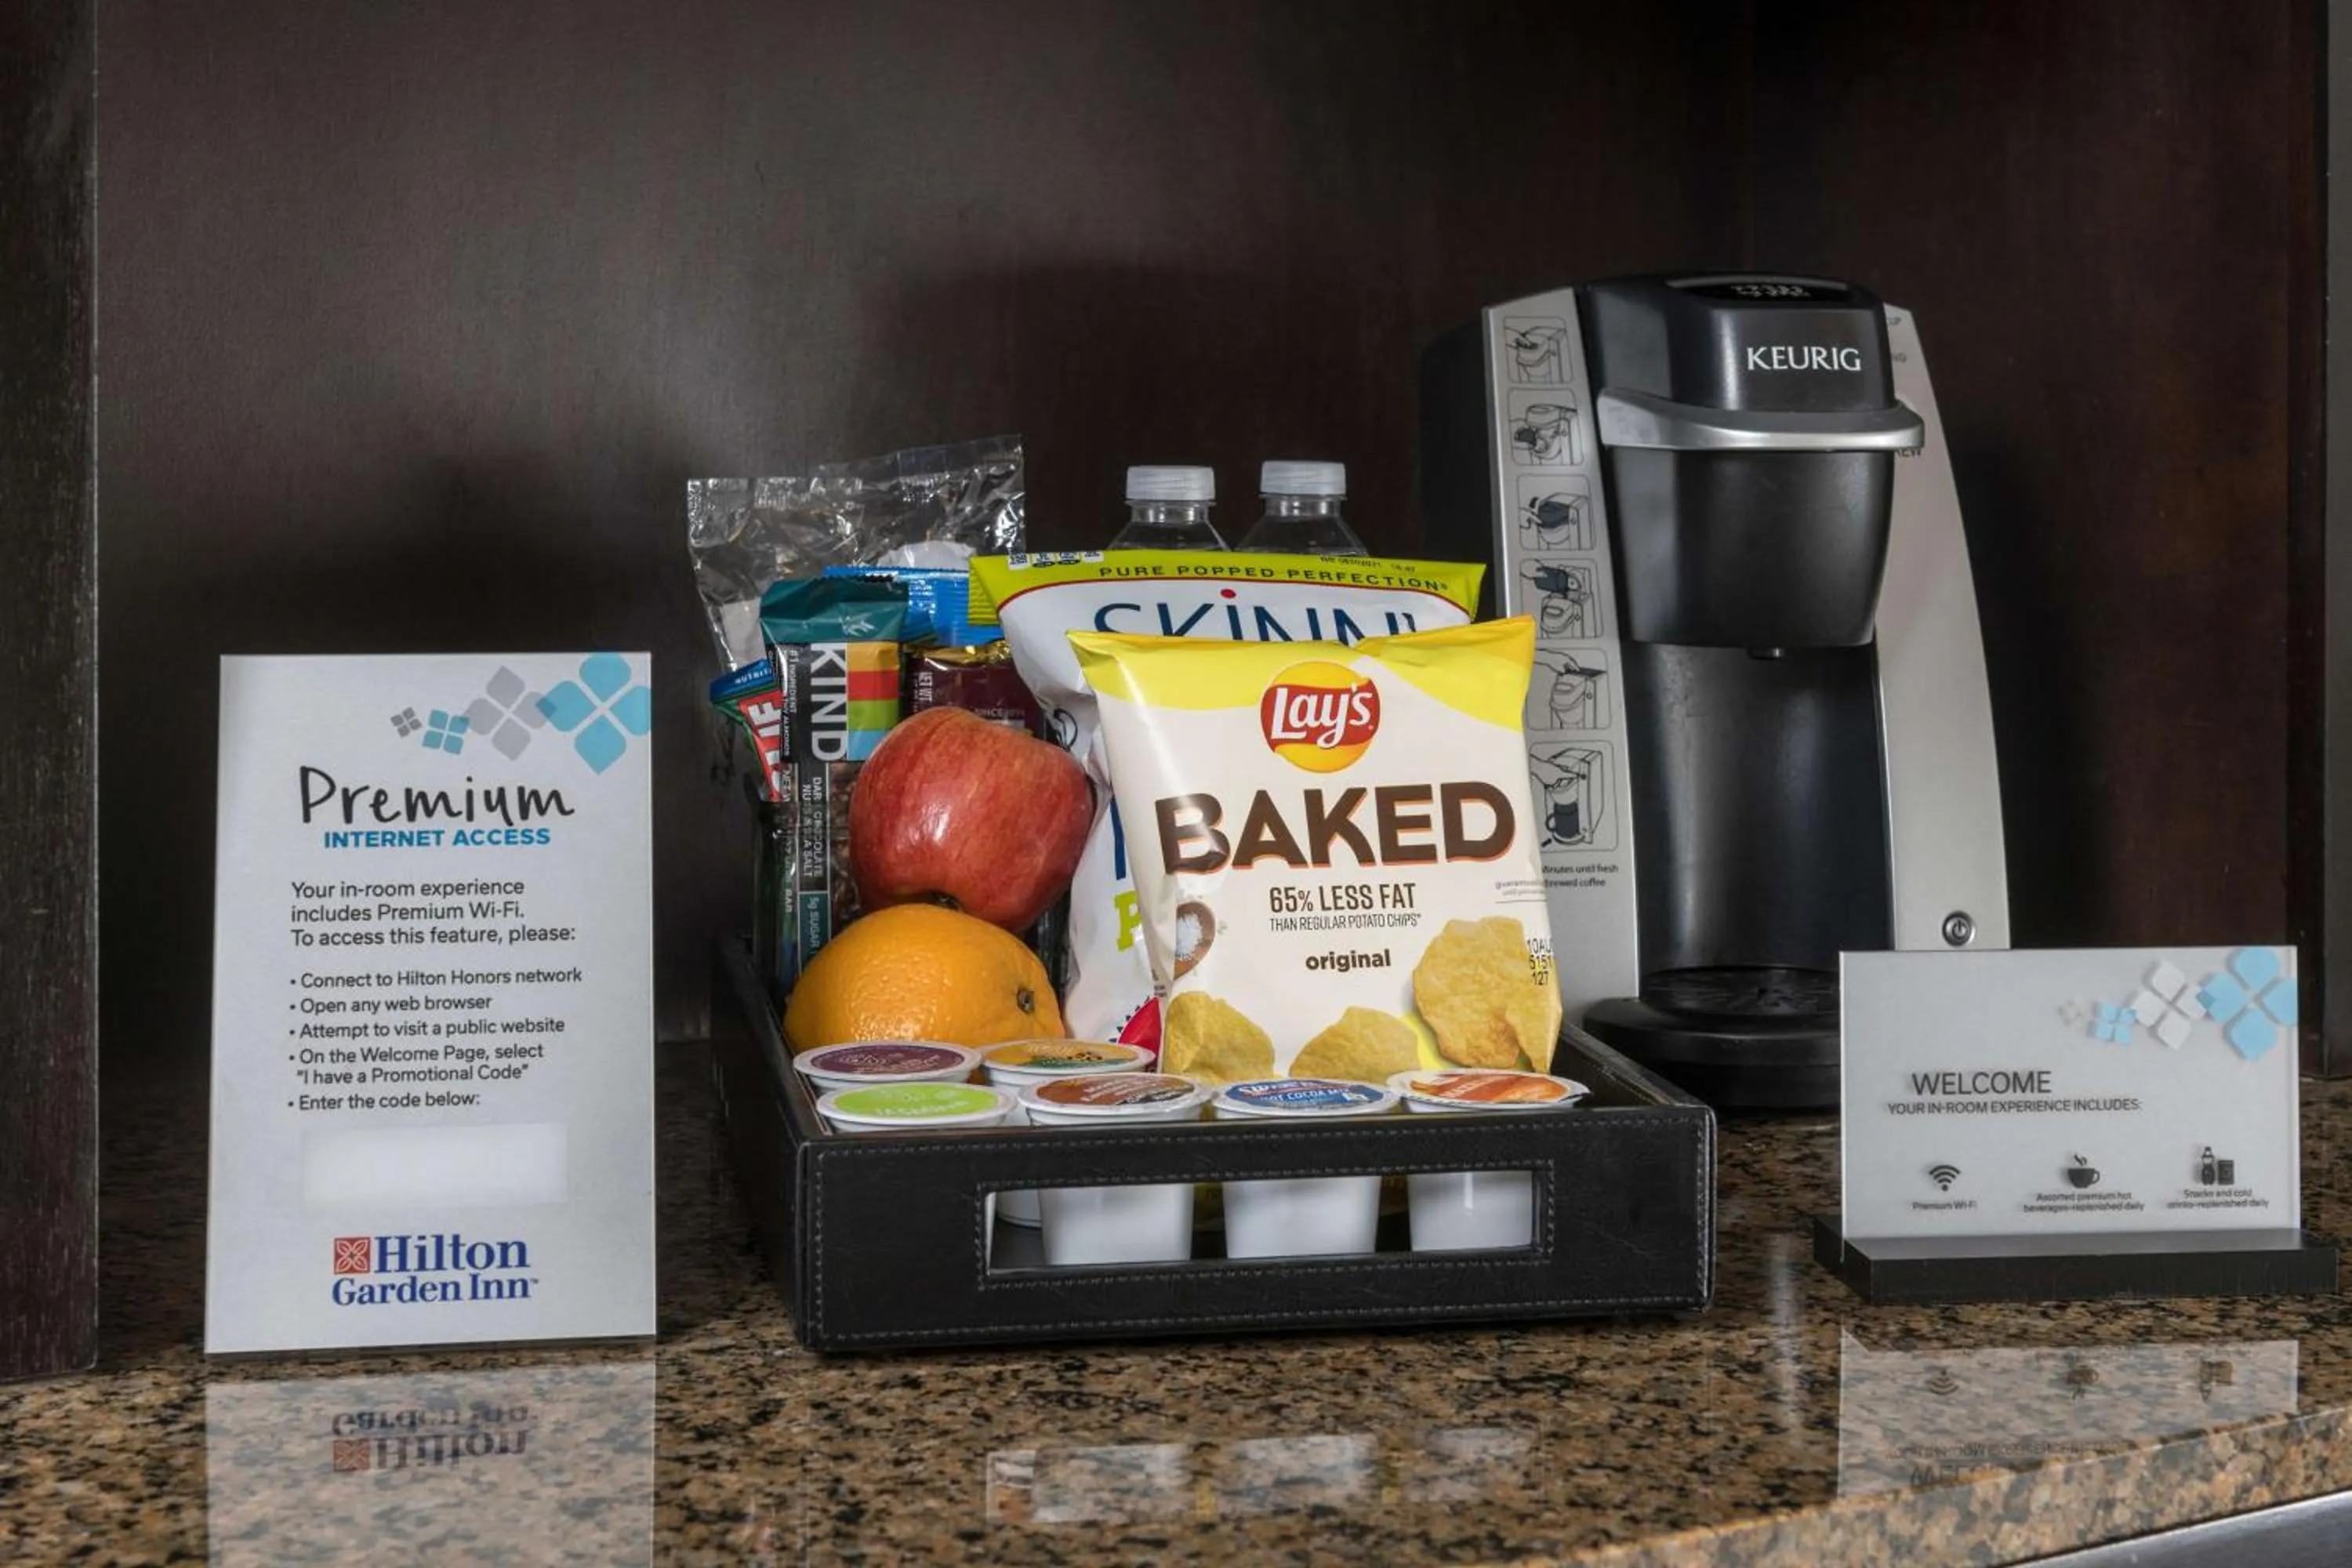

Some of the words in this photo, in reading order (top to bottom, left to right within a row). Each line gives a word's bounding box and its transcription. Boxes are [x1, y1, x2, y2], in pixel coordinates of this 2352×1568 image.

[1747, 346, 1862, 372] KEURIG
[1099, 566, 1166, 577] PURE
[1178, 565, 1274, 578] POPPED
[811, 643, 848, 761] KIND
[1271, 682, 1373, 748] Lay's
[299, 765, 575, 826] Premium
[812, 777, 822, 808] DAR
[324, 829, 445, 848] INTERNET
[452, 828, 551, 846] ACCESS
[1155, 781, 1516, 876] BAKED
[1575, 864, 1595, 873] until
[1597, 863, 1618, 873] fresh
[292, 882, 335, 898] Your
[340, 881, 415, 898] in-room
[421, 880, 524, 901] experience
[1579, 877, 1606, 887] coffee
[1269, 886, 1314, 913] 65%
[1319, 884, 1374, 911] LESS
[1379, 883, 1416, 909] FAT
[292, 906, 372, 921] includes
[378, 904, 464, 920] Premium
[469, 902, 524, 918] Wi-Fi.
[1269, 917, 1298, 931] THAN
[1299, 916, 1346, 931] REGULAR
[1348, 913, 1385, 928] POTATO
[292, 931, 313, 946] To
[319, 931, 384, 945] access
[390, 928, 424, 944] this
[430, 927, 502, 946] feature,
[509, 926, 575, 946] please:
[1305, 949, 1391, 973] original
[301, 972, 372, 988] Connect
[376, 973, 392, 986] to
[397, 971, 446, 985] Hilton
[452, 970, 511, 985] Honors
[515, 967, 582, 983] network
[301, 998, 346, 1017] Open
[351, 1000, 379, 1016] any
[385, 996, 420, 1011] web
[424, 995, 492, 1010] browser
[300, 1024, 368, 1042] Attempt
[374, 1024, 390, 1037] to
[394, 1021, 429, 1036] visit
[432, 1024, 441, 1036] a
[446, 1019, 496, 1039] public
[502, 1018, 565, 1034] website
[300, 1049, 325, 1064] On
[329, 1048, 356, 1063] the
[361, 1047, 439, 1062] Welcome
[444, 1046, 490, 1065] Page,
[495, 1044, 544, 1060] select
[314, 1069, 354, 1083] have
[358, 1072, 367, 1083] a
[372, 1067, 474, 1083] Promotional
[1911, 1070, 2053, 1096] WELCOME
[299, 1096, 343, 1111] Enter
[348, 1095, 375, 1109] the
[379, 1094, 421, 1109] code
[425, 1092, 481, 1107] below:
[1286, 1090, 1326, 1101] COCOA
[1888, 1102, 1926, 1115] YOUR
[1928, 1101, 1987, 1114] IN-ROOM
[1991, 1099, 2071, 1112] EXPERIENCE
[2074, 1098, 2142, 1112] INCLUDES:
[374, 1234, 530, 1273] Hilton
[332, 1276, 462, 1306] Garden
